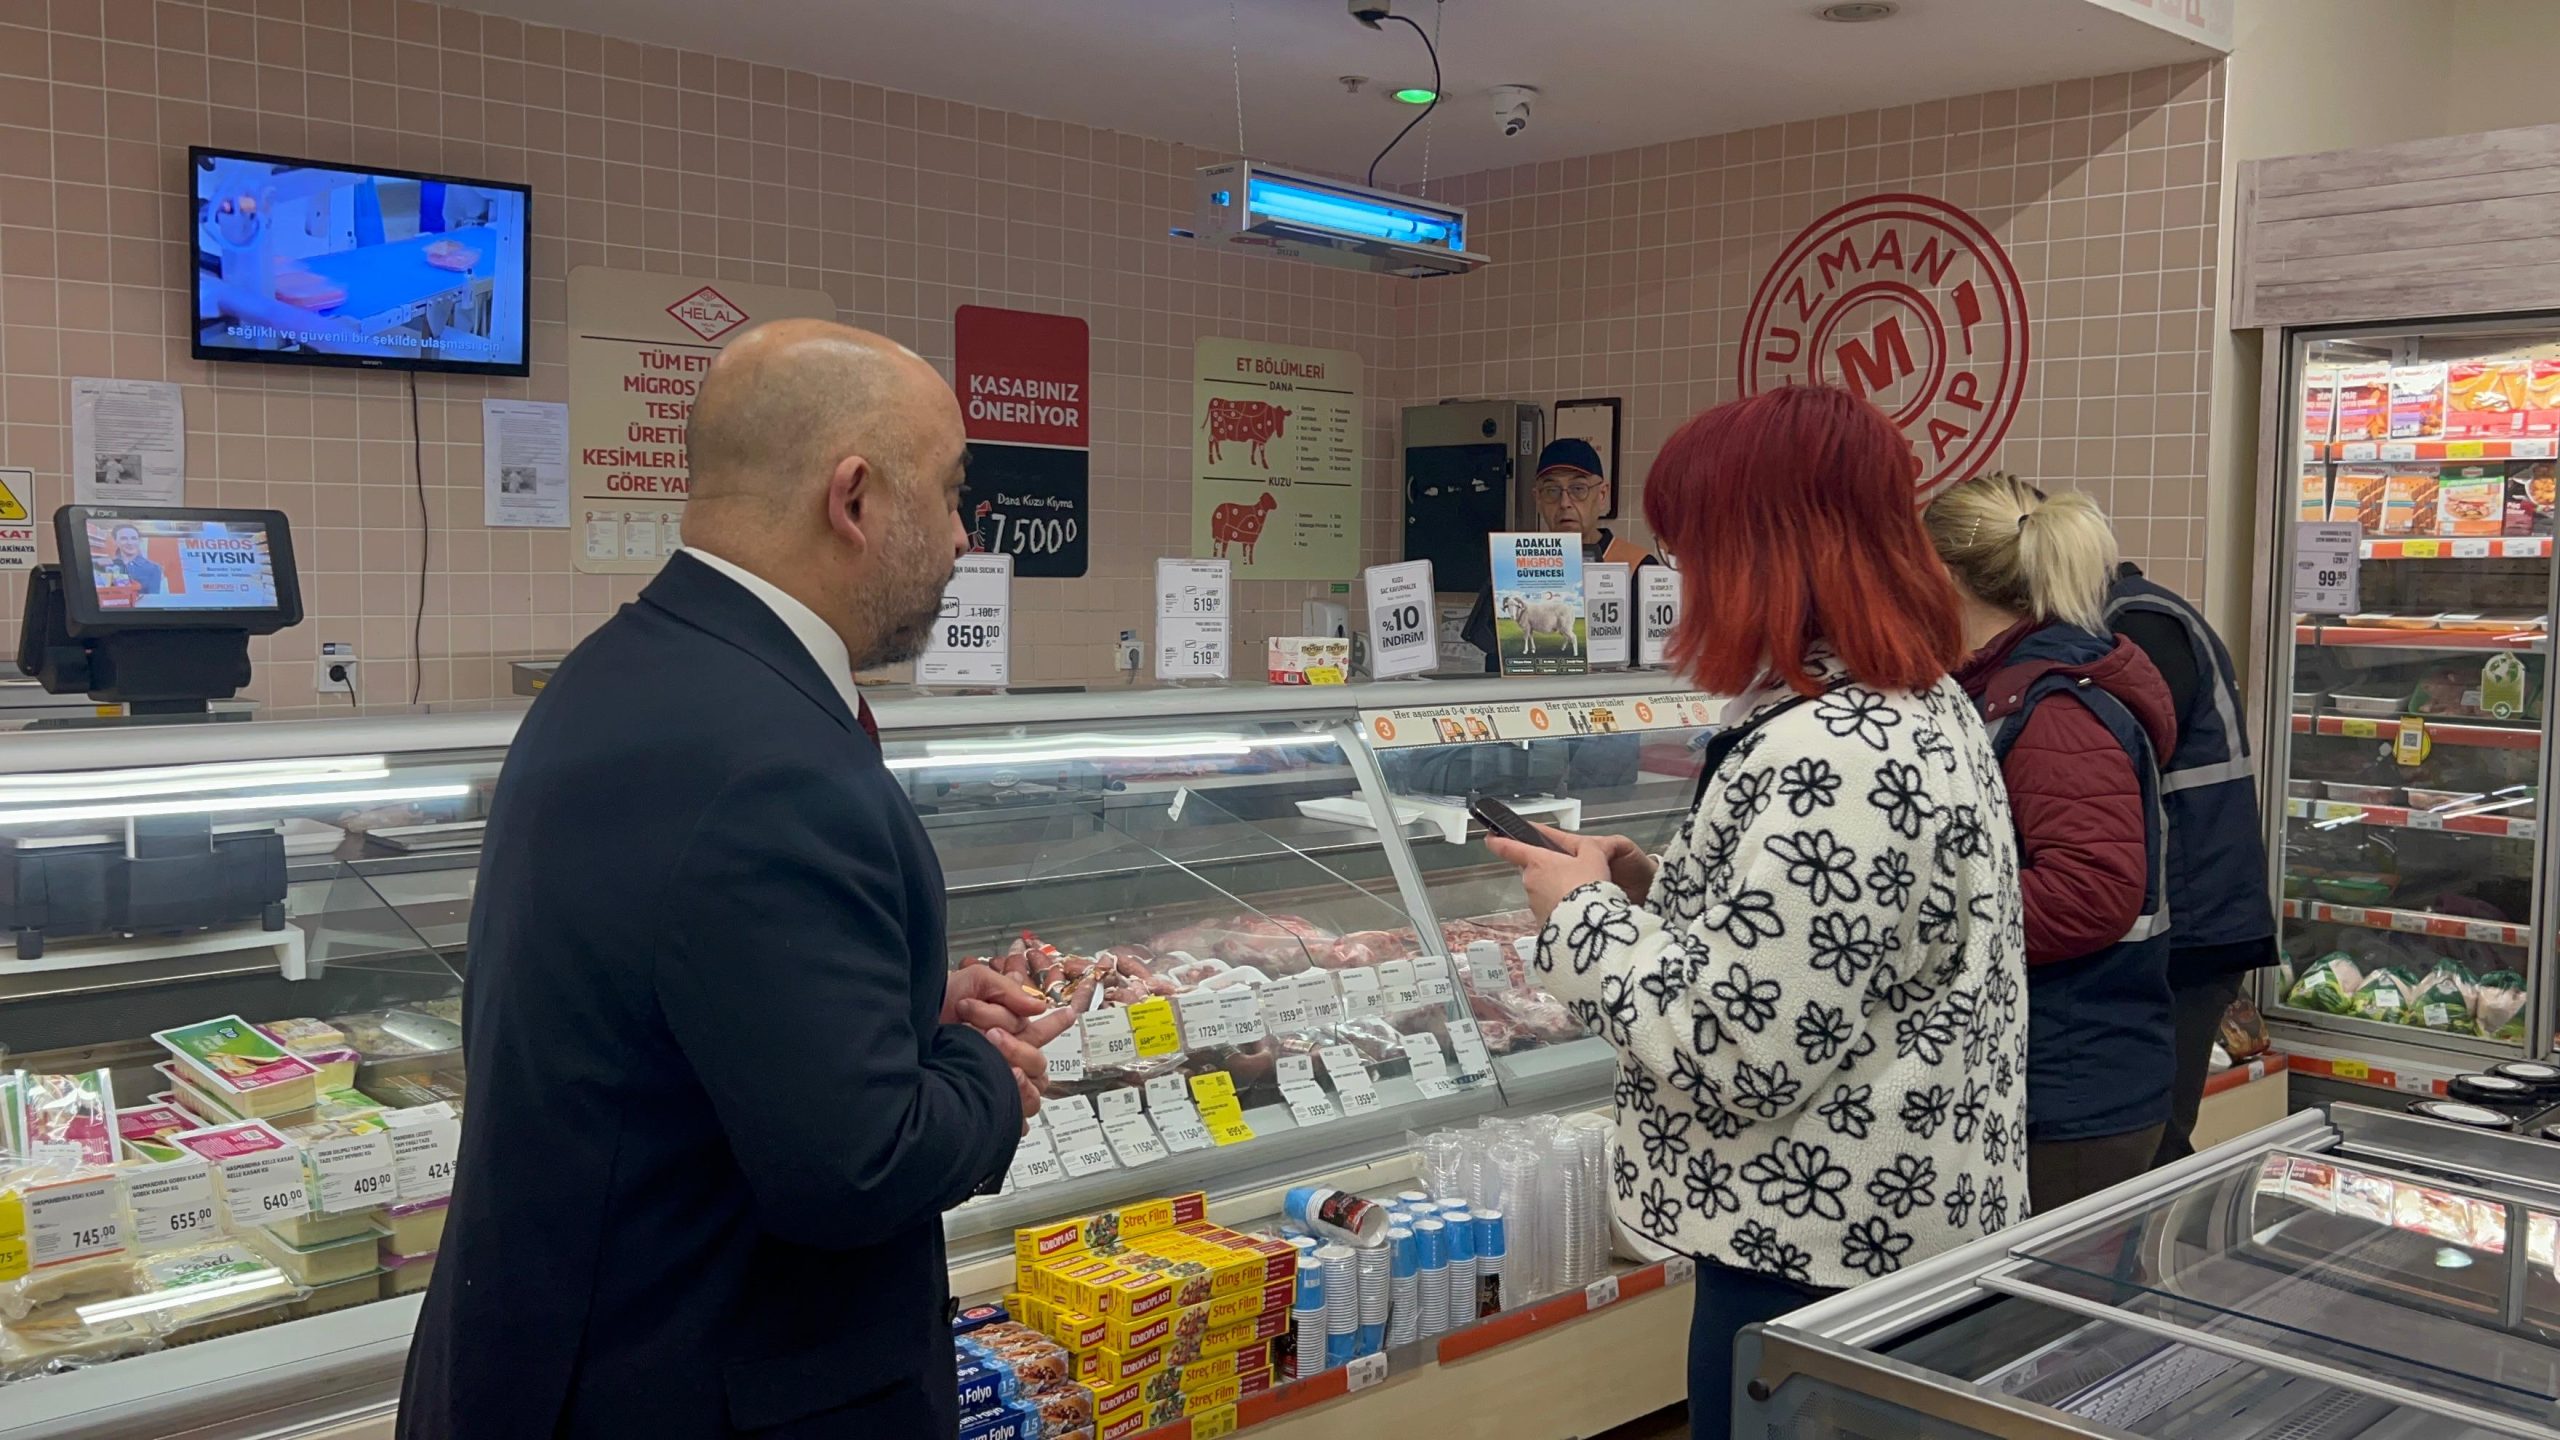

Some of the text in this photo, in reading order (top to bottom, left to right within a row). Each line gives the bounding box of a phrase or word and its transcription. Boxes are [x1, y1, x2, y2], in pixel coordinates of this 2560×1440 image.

[1765, 229, 1957, 363] UZMAN
[681, 307, 736, 323] HELAL
[227, 325, 277, 341] sağlıklı
[280, 329, 296, 340] ve
[373, 333, 417, 348] şekilde
[639, 349, 680, 370] TÜM
[1237, 357, 1325, 380] ET BÖLÜMLERİ
[624, 373, 695, 396] MİGROS
[970, 374, 1079, 402] KASABINIZ
[1269, 381, 1293, 392] DANA
[969, 396, 1079, 427] ÖNERİYOR
[583, 446, 676, 469] KESİMLER
[607, 472, 657, 492] GÖRE
[1269, 477, 1292, 487] KUZU
[997, 493, 1020, 506] Dana
[1023, 494, 1045, 507] Kuzu
[1515, 538, 1562, 548] ADAKLIK
[1515, 549, 1563, 557] KURBANDA
[1382, 605, 1420, 631] %10
[1592, 602, 1618, 623] %15
[1649, 605, 1673, 625] %10
[1380, 722, 1392, 737] 3
[1393, 710, 1410, 719] Her
[1412, 707, 1450, 719] aşamada
[1470, 705, 1495, 716] soğuk
[1535, 711, 1545, 726] 4
[1545, 702, 1560, 711] Her
[1562, 701, 1577, 711] gün
[1579, 700, 1595, 708] taze
[1639, 707, 1649, 720] 5
[1040, 1229, 1076, 1253] KOROPLAST
[1123, 1212, 1147, 1228] Streç
[1149, 1208, 1168, 1221] Film
[1133, 1266, 1262, 1314] KOROPLAST Cling Film
[1131, 1295, 1257, 1346] KOROPLAST Streç Film
[1122, 1325, 1250, 1376] KOROPLAST Streç Film
[966, 1379, 1015, 1404] Folyo 15
[1100, 1359, 1231, 1411] KOROPLAST Streç Film
[1189, 1391, 1212, 1408] Streç
[1215, 1386, 1234, 1400] Film
[990, 1418, 1038, 1440] Folyo 15
